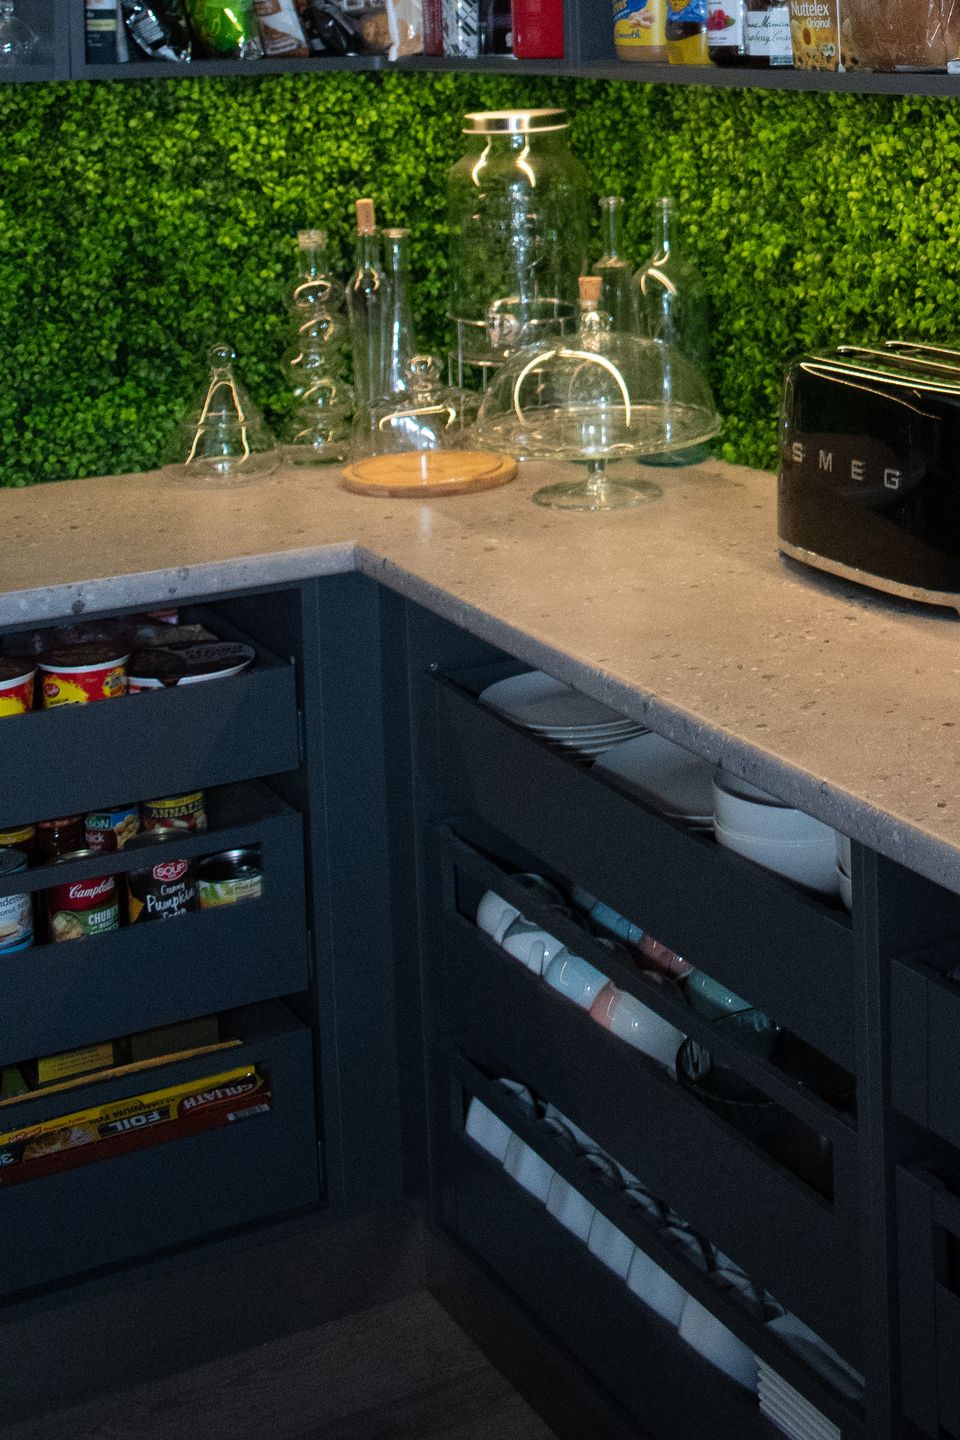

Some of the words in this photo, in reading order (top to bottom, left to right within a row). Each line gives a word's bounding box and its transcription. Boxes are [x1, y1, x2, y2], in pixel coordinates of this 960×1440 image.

[791, 0, 830, 17] Nuttelex
[807, 16, 831, 31] Original
[793, 441, 902, 490] SMEG
[108, 1108, 161, 1133] FOIL
